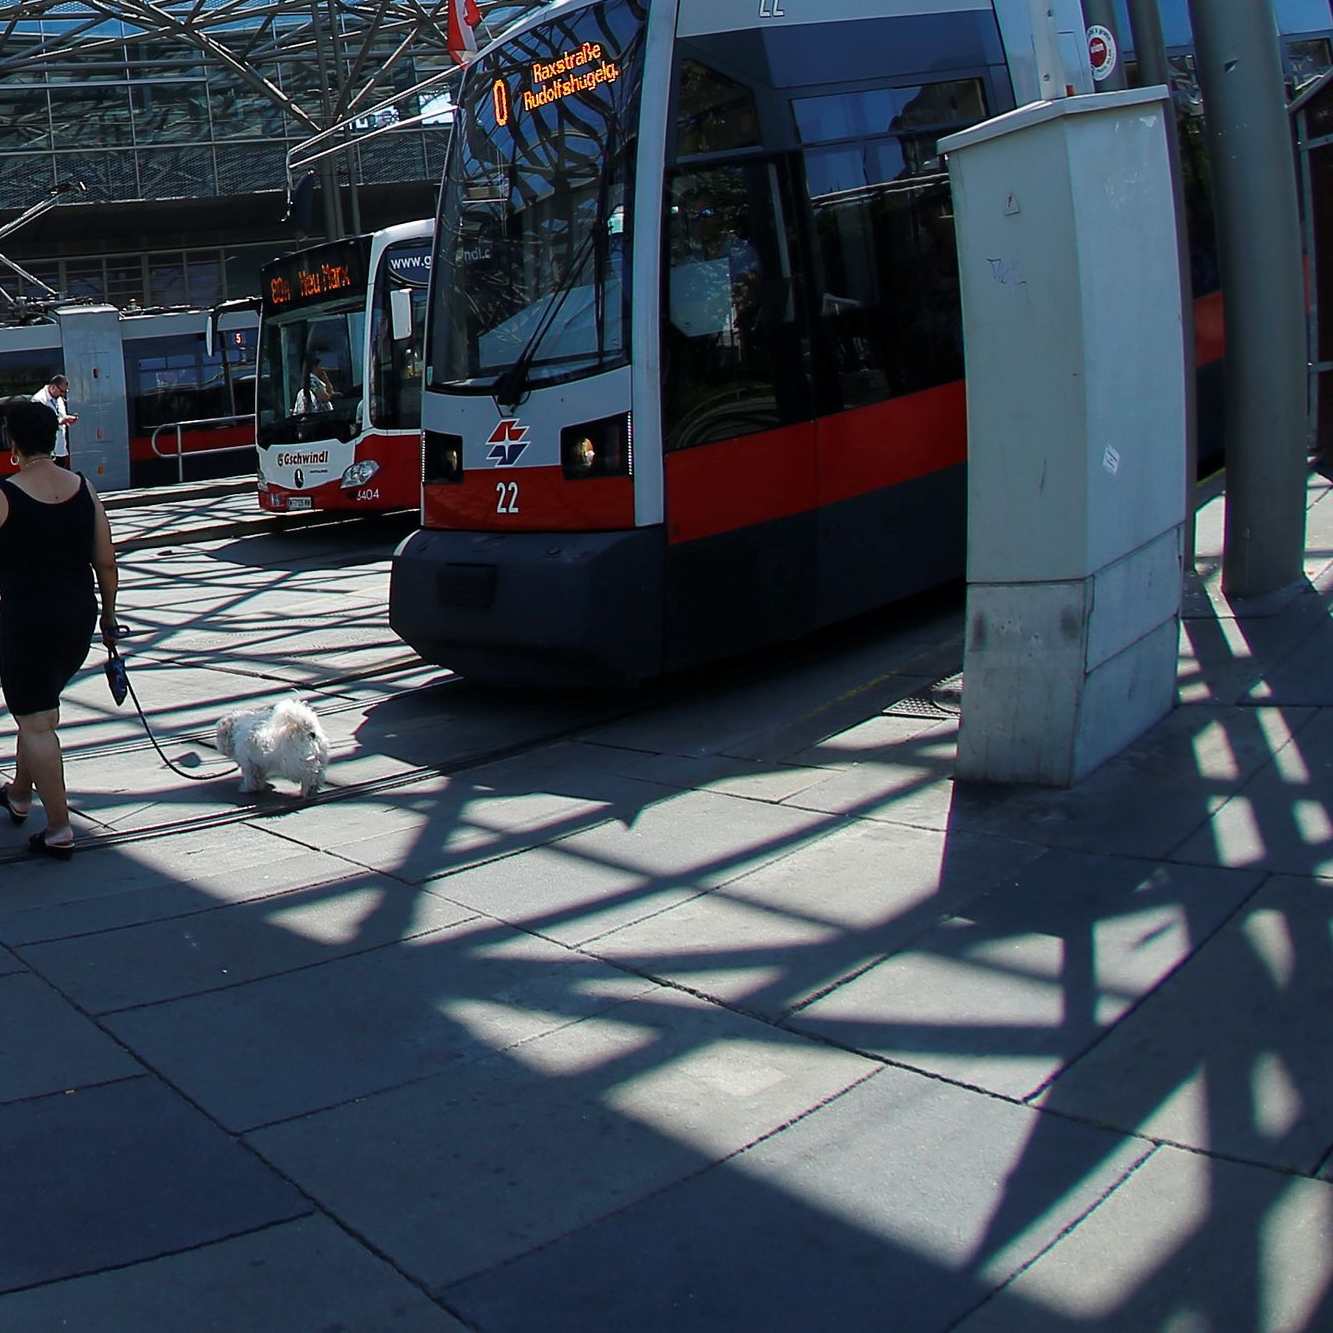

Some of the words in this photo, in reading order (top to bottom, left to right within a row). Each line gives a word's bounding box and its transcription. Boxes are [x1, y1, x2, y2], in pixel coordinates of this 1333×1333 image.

[533, 42, 601, 83] Raxstraße
[298, 270, 321, 297] Neu
[235, 333, 242, 344] 5
[284, 451, 329, 466] Gschwindl
[496, 482, 519, 513] 22
